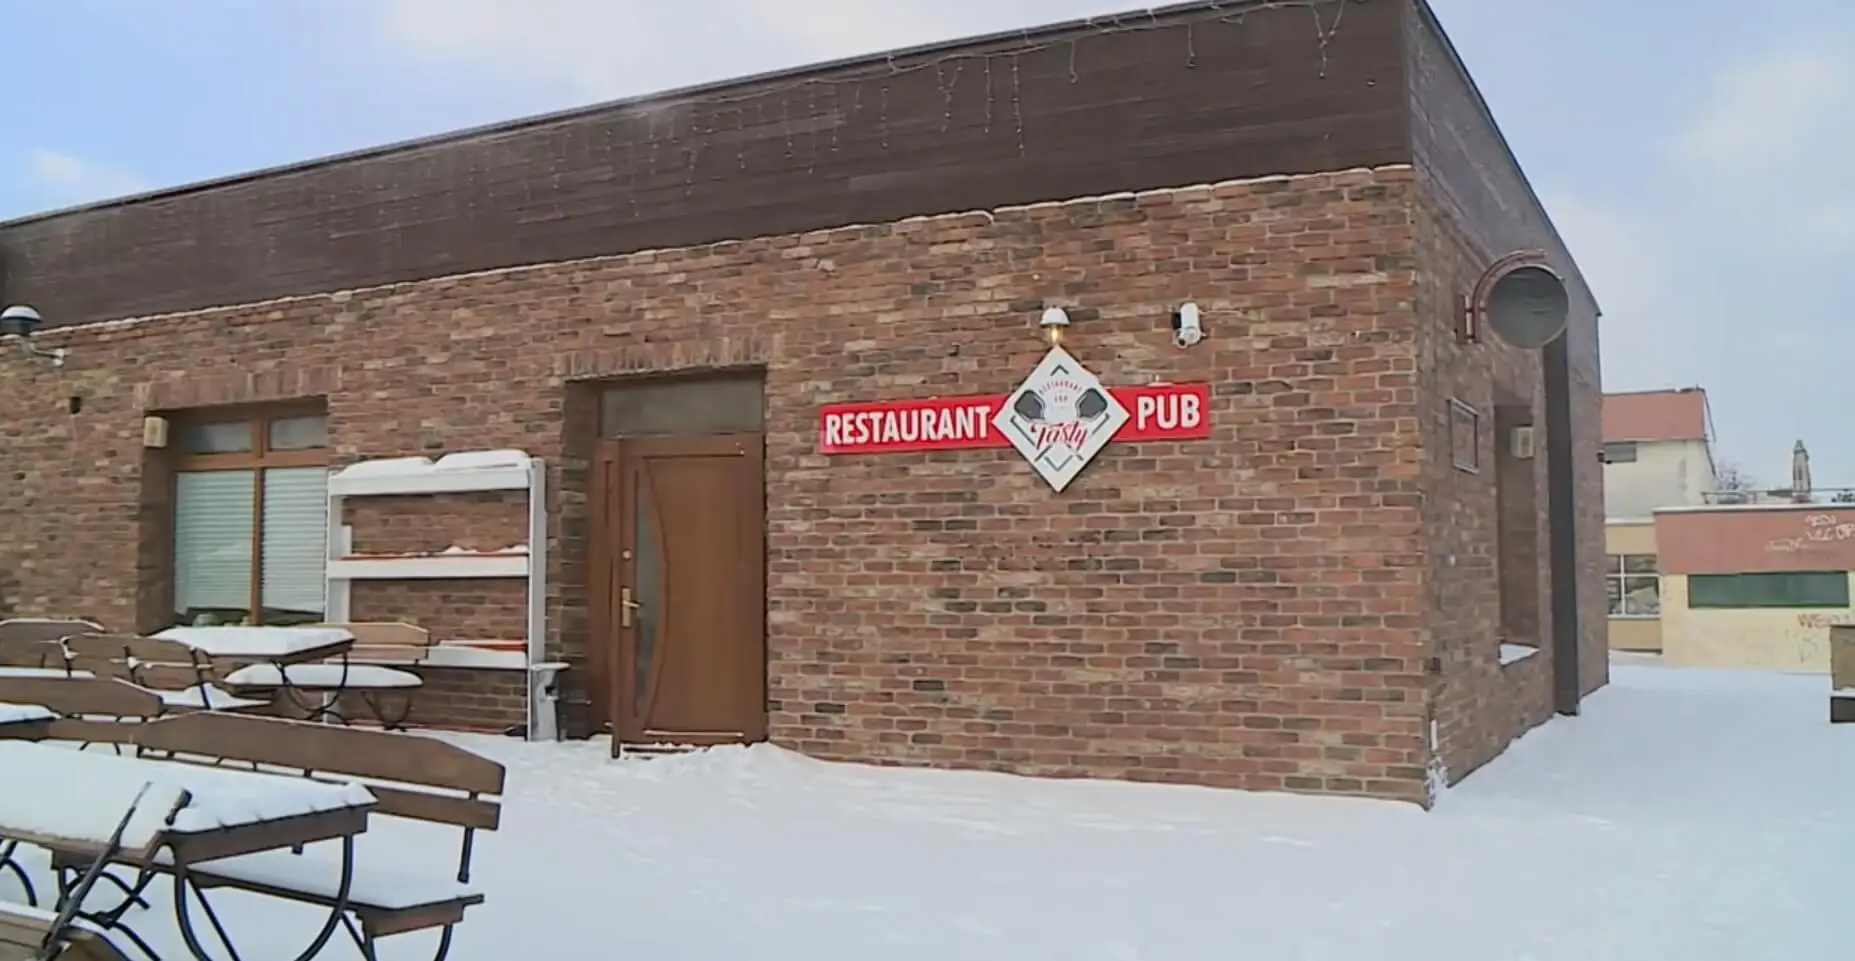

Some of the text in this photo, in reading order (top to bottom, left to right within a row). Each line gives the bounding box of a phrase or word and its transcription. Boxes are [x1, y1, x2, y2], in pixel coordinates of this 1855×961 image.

[825, 394, 1201, 445] RESTAURANT PUB
[1030, 421, 1088, 450] Tasty
